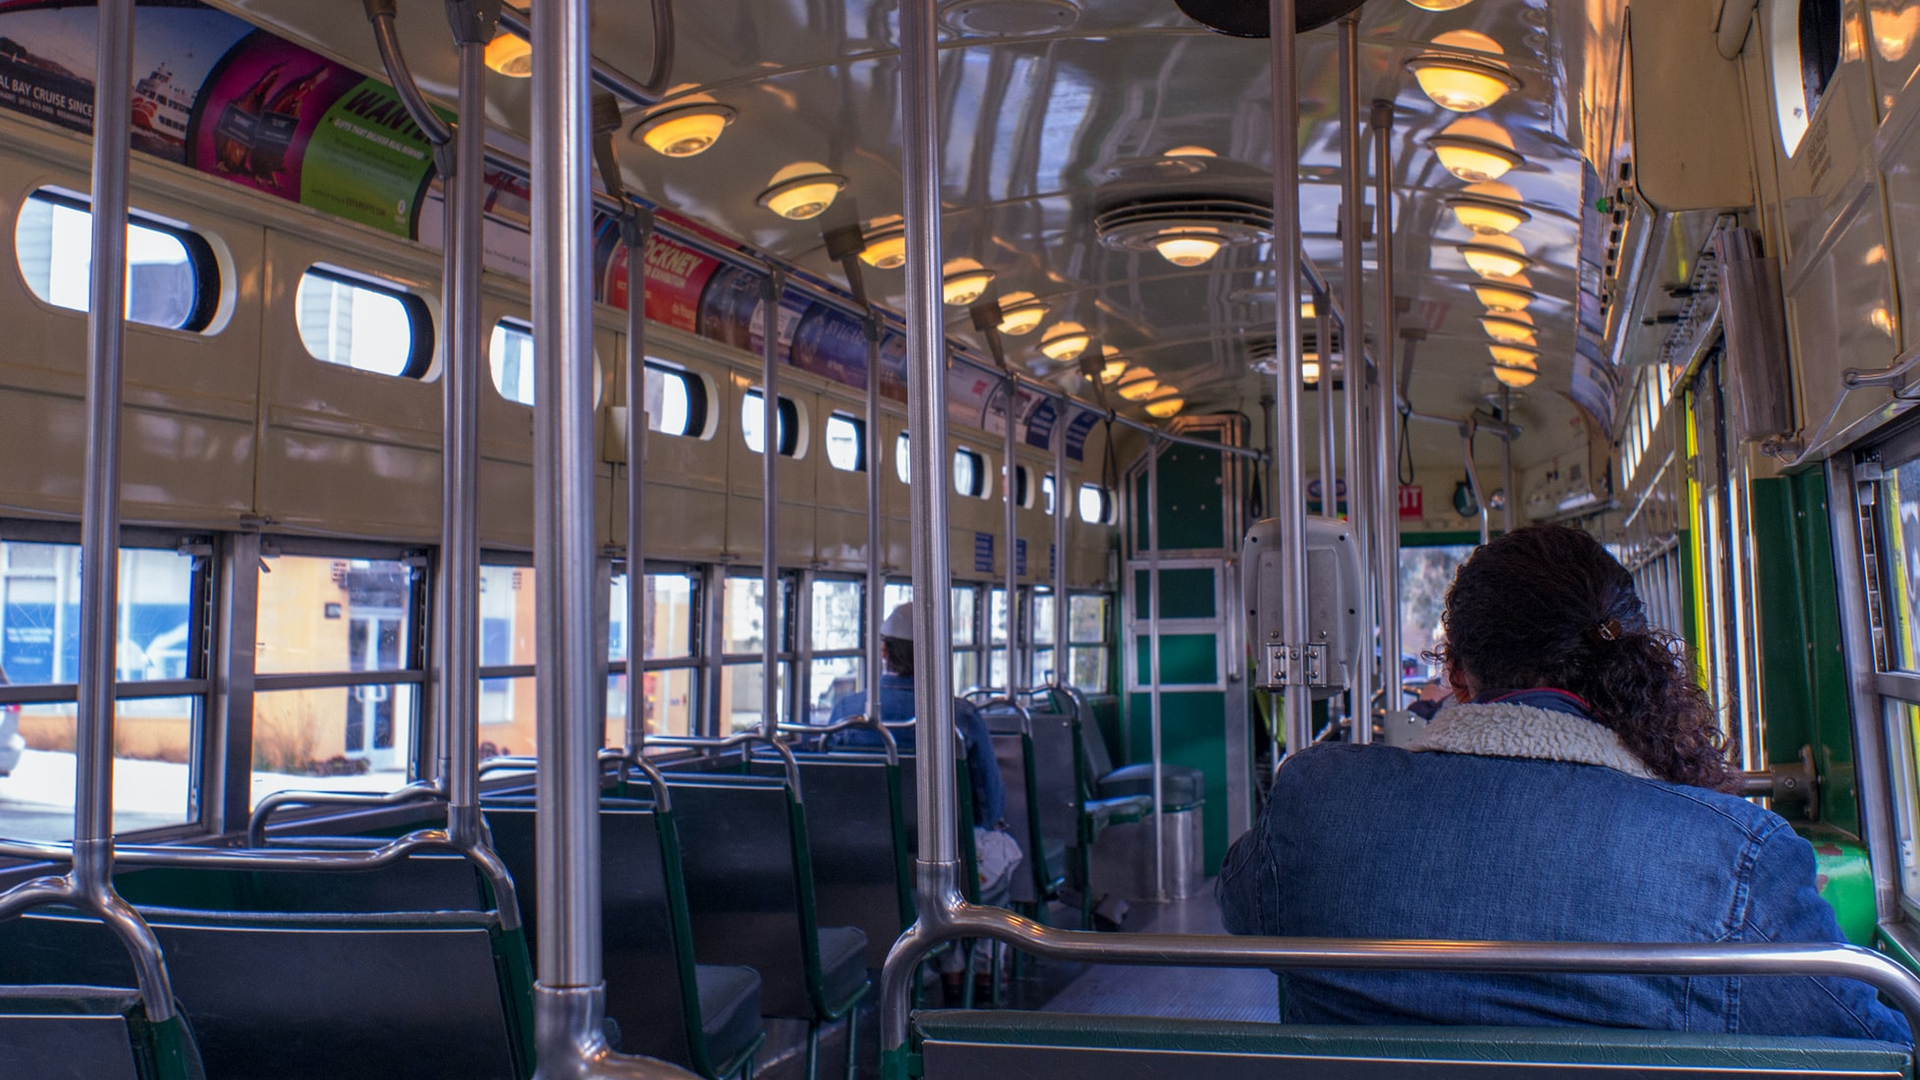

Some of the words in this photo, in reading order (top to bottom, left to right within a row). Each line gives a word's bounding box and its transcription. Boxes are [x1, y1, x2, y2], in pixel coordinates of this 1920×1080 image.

[12, 79, 32, 96] BAY
[33, 86, 66, 108] CRUISE
[67, 97, 94, 118] SINCE
[644, 239, 702, 278] OCKNEY
